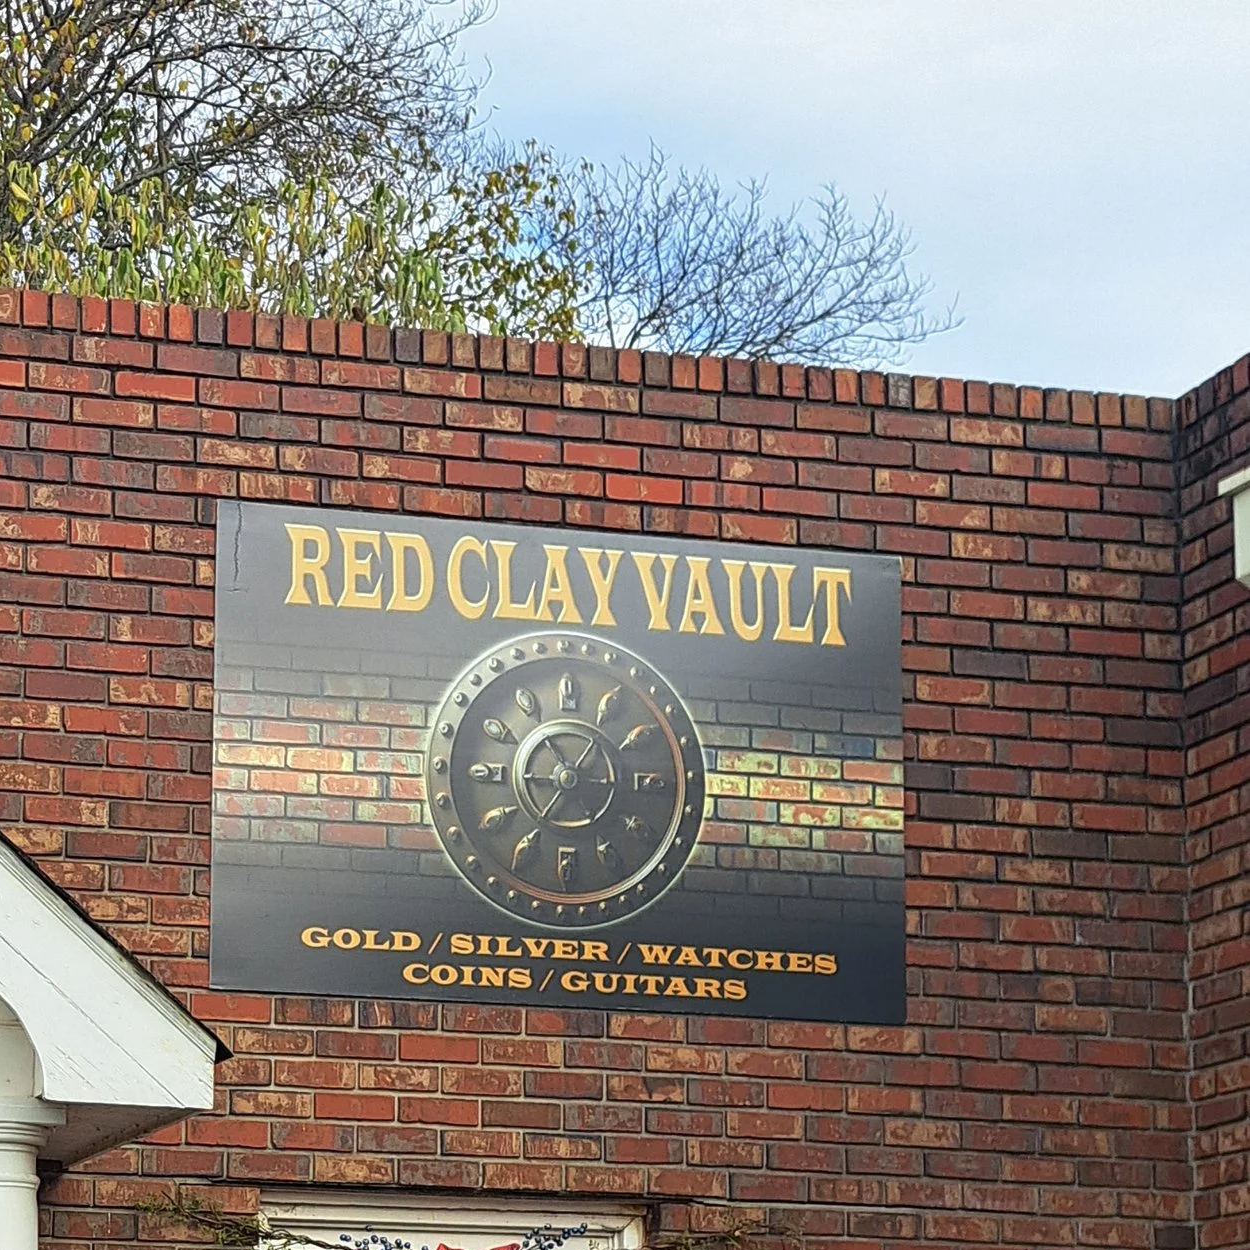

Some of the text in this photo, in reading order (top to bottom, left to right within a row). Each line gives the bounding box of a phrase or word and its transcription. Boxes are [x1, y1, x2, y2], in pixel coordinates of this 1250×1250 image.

[284, 522, 852, 647] RED CLAY VAULT
[301, 926, 422, 952] GOLD
[450, 935, 611, 962] SILVER
[639, 944, 838, 974] WATCHES
[402, 963, 532, 990] COINS
[561, 972, 748, 1001] GUITARS
